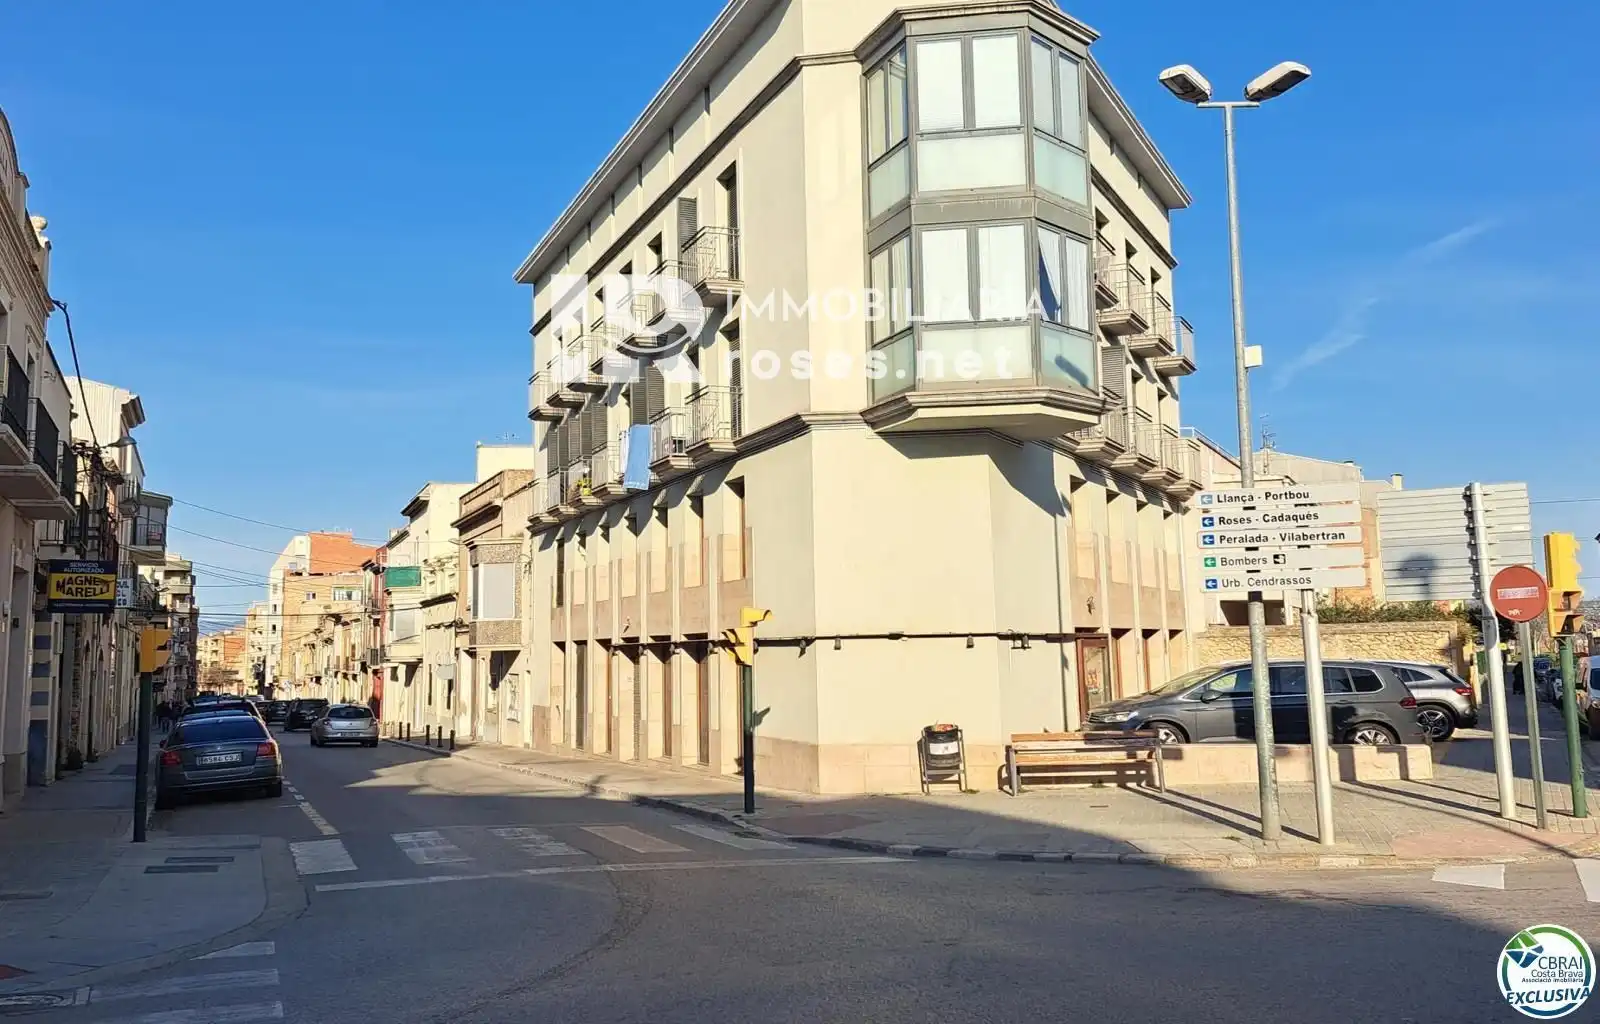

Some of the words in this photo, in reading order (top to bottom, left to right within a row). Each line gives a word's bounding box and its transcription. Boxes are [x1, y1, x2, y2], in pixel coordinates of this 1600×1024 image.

[1216, 494, 1254, 504] Llança
[1264, 491, 1310, 501] Portbou
[1218, 516, 1252, 526] Roses
[1262, 511, 1319, 523] Cadaqués
[1219, 534, 1269, 545] Peralada
[1279, 531, 1345, 542] Vilabertran
[1220, 555, 1268, 567] Bombers
[1222, 577, 1244, 588] Urb.
[1247, 575, 1312, 587] Cendrassos
